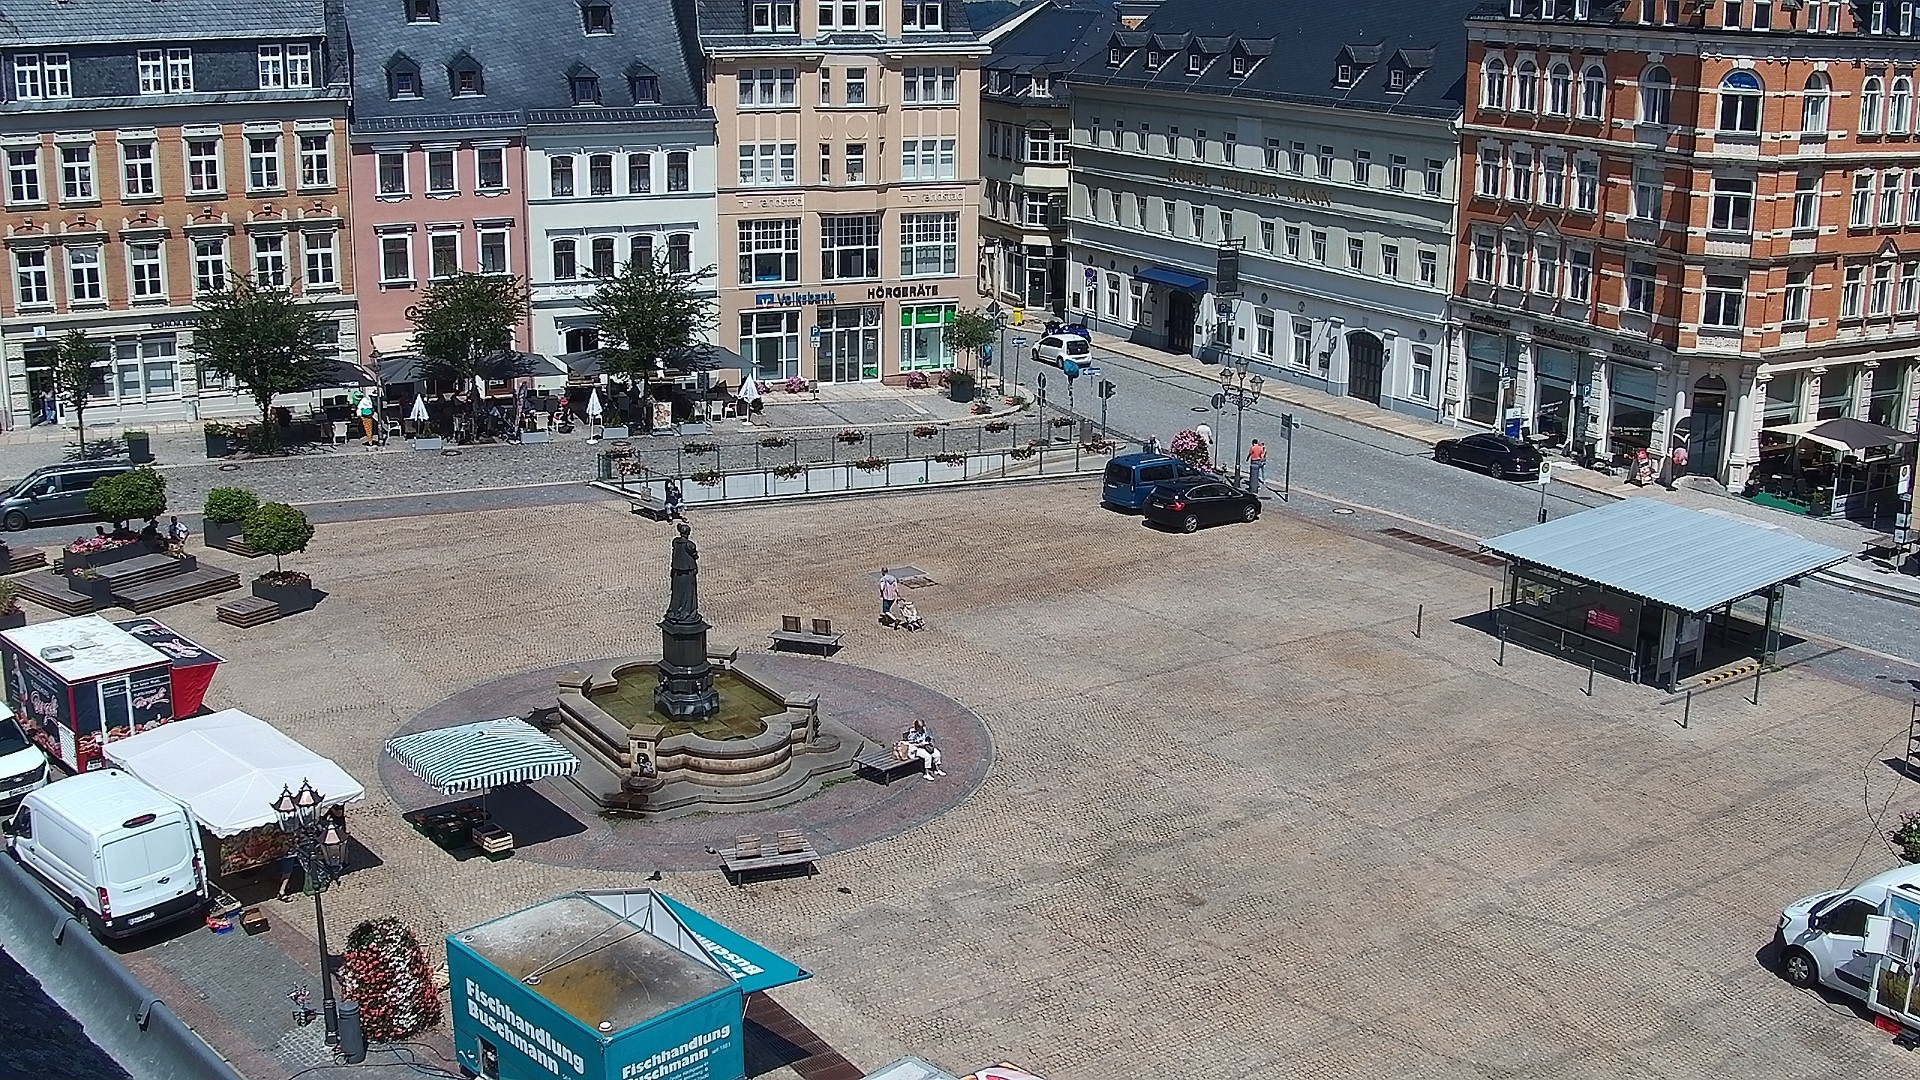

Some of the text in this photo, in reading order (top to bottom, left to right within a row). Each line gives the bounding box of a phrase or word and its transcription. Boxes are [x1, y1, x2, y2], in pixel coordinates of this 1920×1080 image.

[758, 195, 803, 208] randstad
[921, 191, 964, 202] randstad
[1168, 168, 1332, 207] HOTEL WILDER MANN
[777, 290, 836, 305] Volksbank
[867, 284, 939, 300] HÖRGERÄTE
[465, 977, 585, 1075] Fischhandlung
[467, 998, 559, 1075] Buschmann
[622, 1025, 731, 1079] Fischhandlung
[628, 1048, 709, 1080] uschmann
